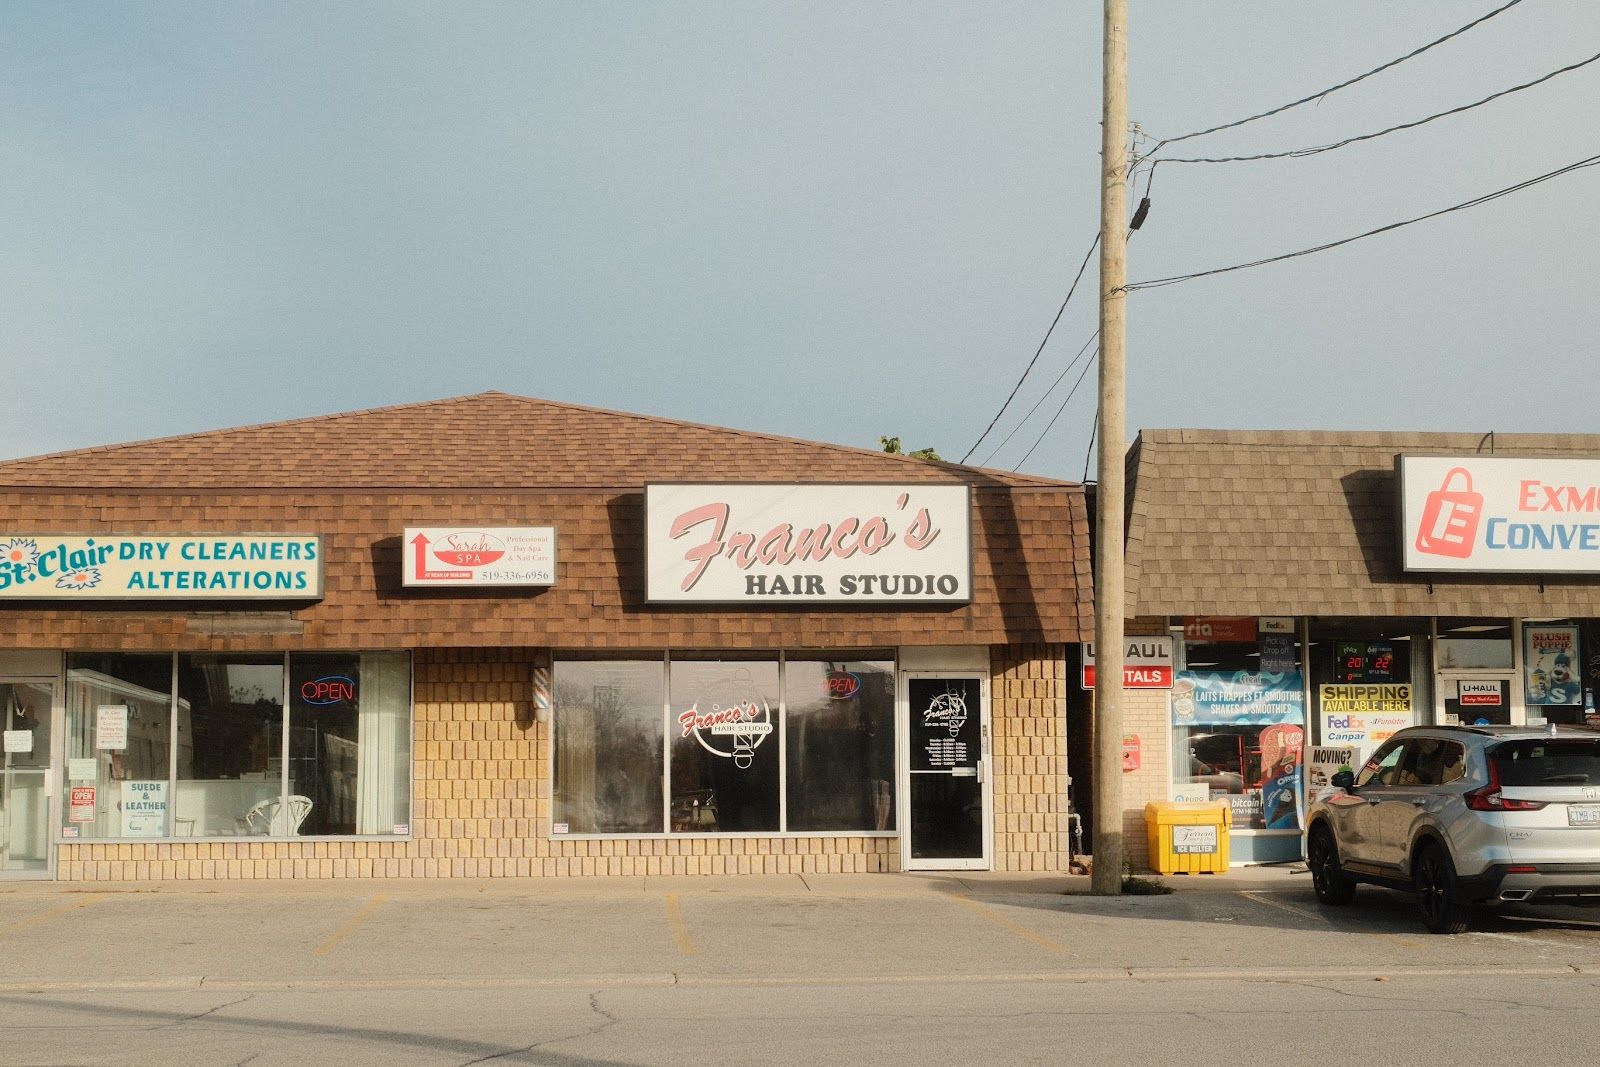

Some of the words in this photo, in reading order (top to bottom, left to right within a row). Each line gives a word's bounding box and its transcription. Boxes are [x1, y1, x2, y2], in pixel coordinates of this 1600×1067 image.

[447, 535, 492, 552] Sarah
[668, 493, 941, 592] Franco's
[119, 542, 171, 561] DRY
[181, 542, 316, 561] CLEANERS
[0, 561, 37, 590] St.
[37, 538, 115, 578] Clair
[457, 554, 481, 563] SPA
[127, 571, 308, 589] ALTERATIONS
[481, 570, 549, 581] 519-336-6956
[744, 574, 826, 595] HAIR
[839, 574, 959, 595] STUDIO
[1187, 617, 1213, 636] ria
[1266, 621, 1285, 629] FedEx
[1532, 633, 1571, 641] SLUSH
[1533, 640, 1571, 649] PUPPIE
[1263, 647, 1278, 655] Drop
[1279, 646, 1289, 654] off
[1261, 658, 1279, 668] Right
[1347, 657, 1361, 668] 20
[1375, 657, 1390, 669] 22
[302, 681, 353, 700] OPEN
[821, 678, 857, 693] OPEN
[1196, 691, 1218, 702] LAITS
[1254, 691, 1264, 702] ET
[1324, 686, 1409, 699] SHIPPING
[1210, 704, 1240, 714] SHAKES
[1241, 704, 1249, 714] &
[1251, 704, 1292, 714] SMOOTHIES
[1325, 701, 1379, 711] AVAILABLE
[1382, 701, 1408, 711] HERE
[678, 700, 760, 737] Franco's
[1328, 715, 1365, 728] FedEx
[1328, 732, 1365, 741] Canpar
[1313, 749, 1352, 765] MOVING?
[131, 783, 161, 791] SUEDE
[73, 791, 93, 800] OPEN
[142, 791, 150, 800] &
[125, 801, 167, 810] LEATHER
[1231, 797, 1259, 807] bitcoin
